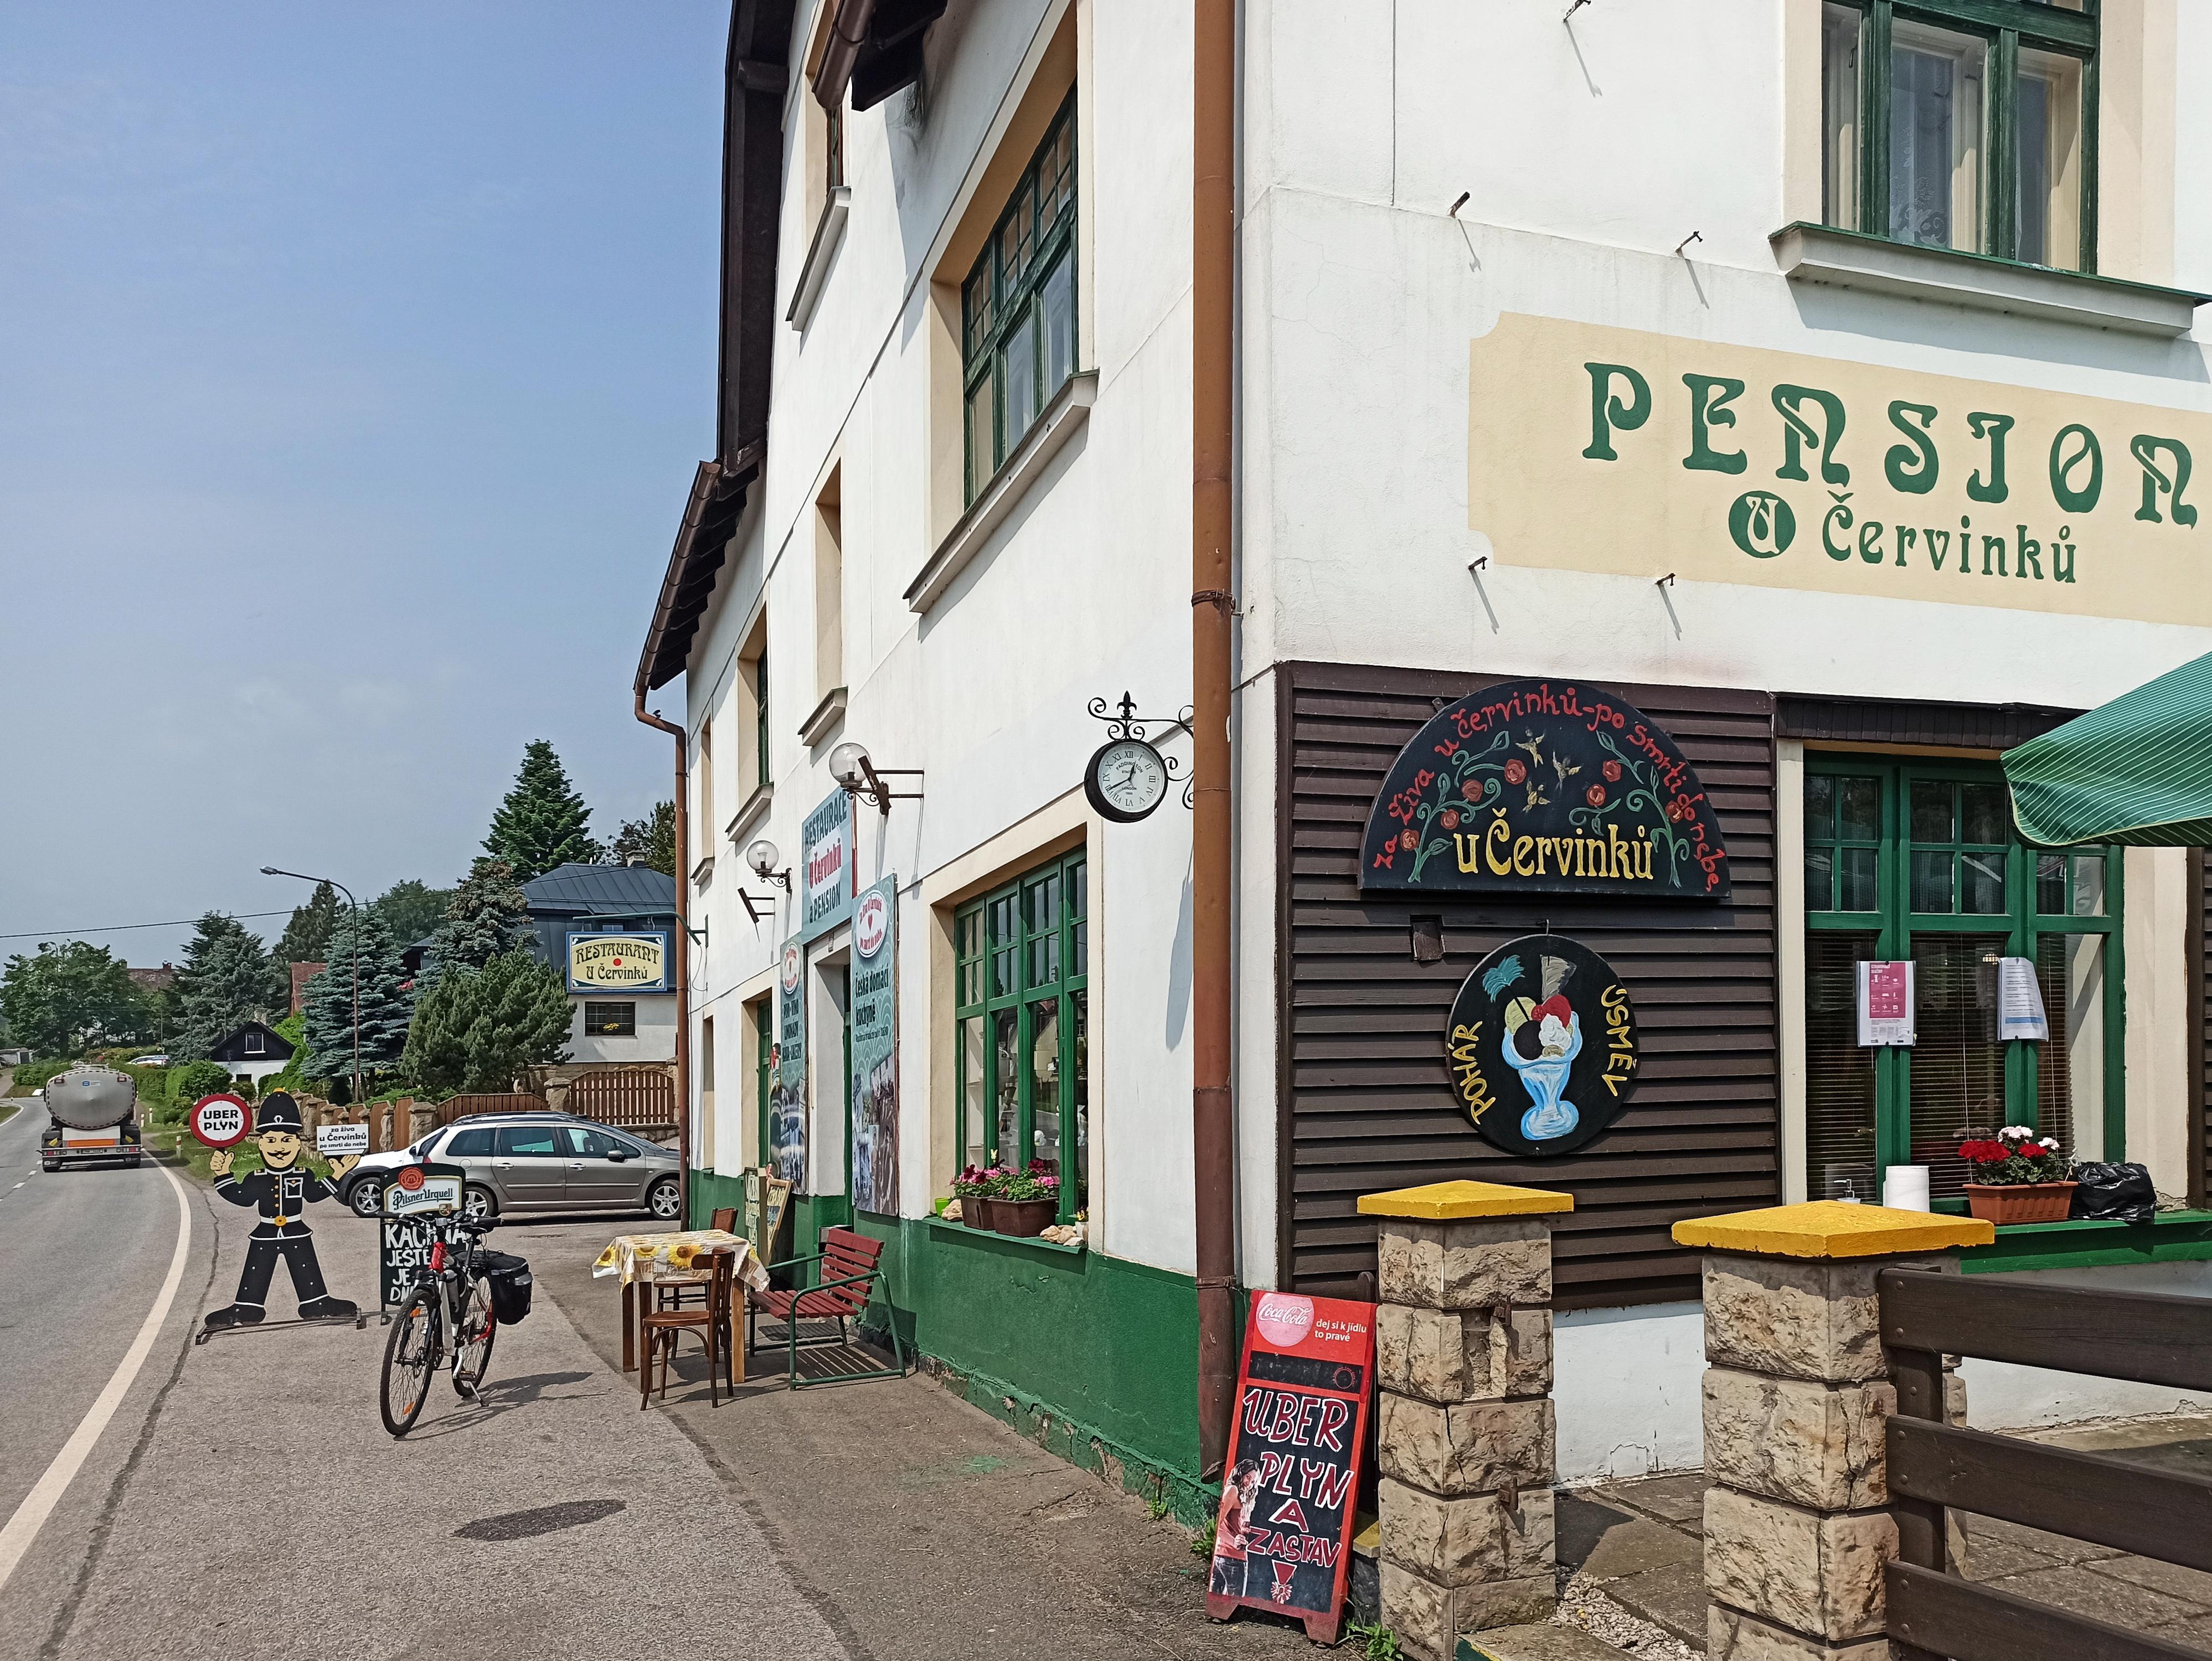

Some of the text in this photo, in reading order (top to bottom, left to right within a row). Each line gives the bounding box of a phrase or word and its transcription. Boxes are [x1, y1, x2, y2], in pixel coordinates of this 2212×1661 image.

[1582, 361, 2198, 530] PENSION
[1821, 489, 2077, 584] Červinků
[1435, 739, 1460, 756] u
[1116, 761, 1143, 773] PADDINGTON
[1677, 793, 1704, 821] do
[805, 790, 847, 854] RESTAURACE
[1373, 834, 1397, 869] za
[1485, 807, 1654, 880] Červinků
[1690, 822, 1726, 893] nebe
[809, 881, 841, 924] a PENSION
[576, 943, 659, 964] RESTAURANT
[598, 963, 647, 979] Červinků
[870, 964, 889, 993] domácí
[1601, 984, 1637, 1097] ÚSMĚV
[1447, 1021, 1496, 1125] POHÁR
[203, 1110, 239, 1120] UBER
[204, 1121, 238, 1131] PLYN
[327, 1132, 367, 1141] Červinků
[393, 1187, 453, 1210] Pilsner Urquell
[393, 1268, 411, 1286] JE
[1258, 1303, 1312, 1325] Coca-Cola
[1316, 1319, 1330, 1330] dej
[1332, 1320, 1339, 1329] si
[1346, 1322, 1367, 1333] jídlu
[1325, 1333, 1350, 1342] pravé
[1242, 1388, 1349, 1452] UBER
[1257, 1451, 1354, 1510] PLYN
[1269, 1498, 1309, 1533] A
[1246, 1526, 1342, 1567] ZASTAV
